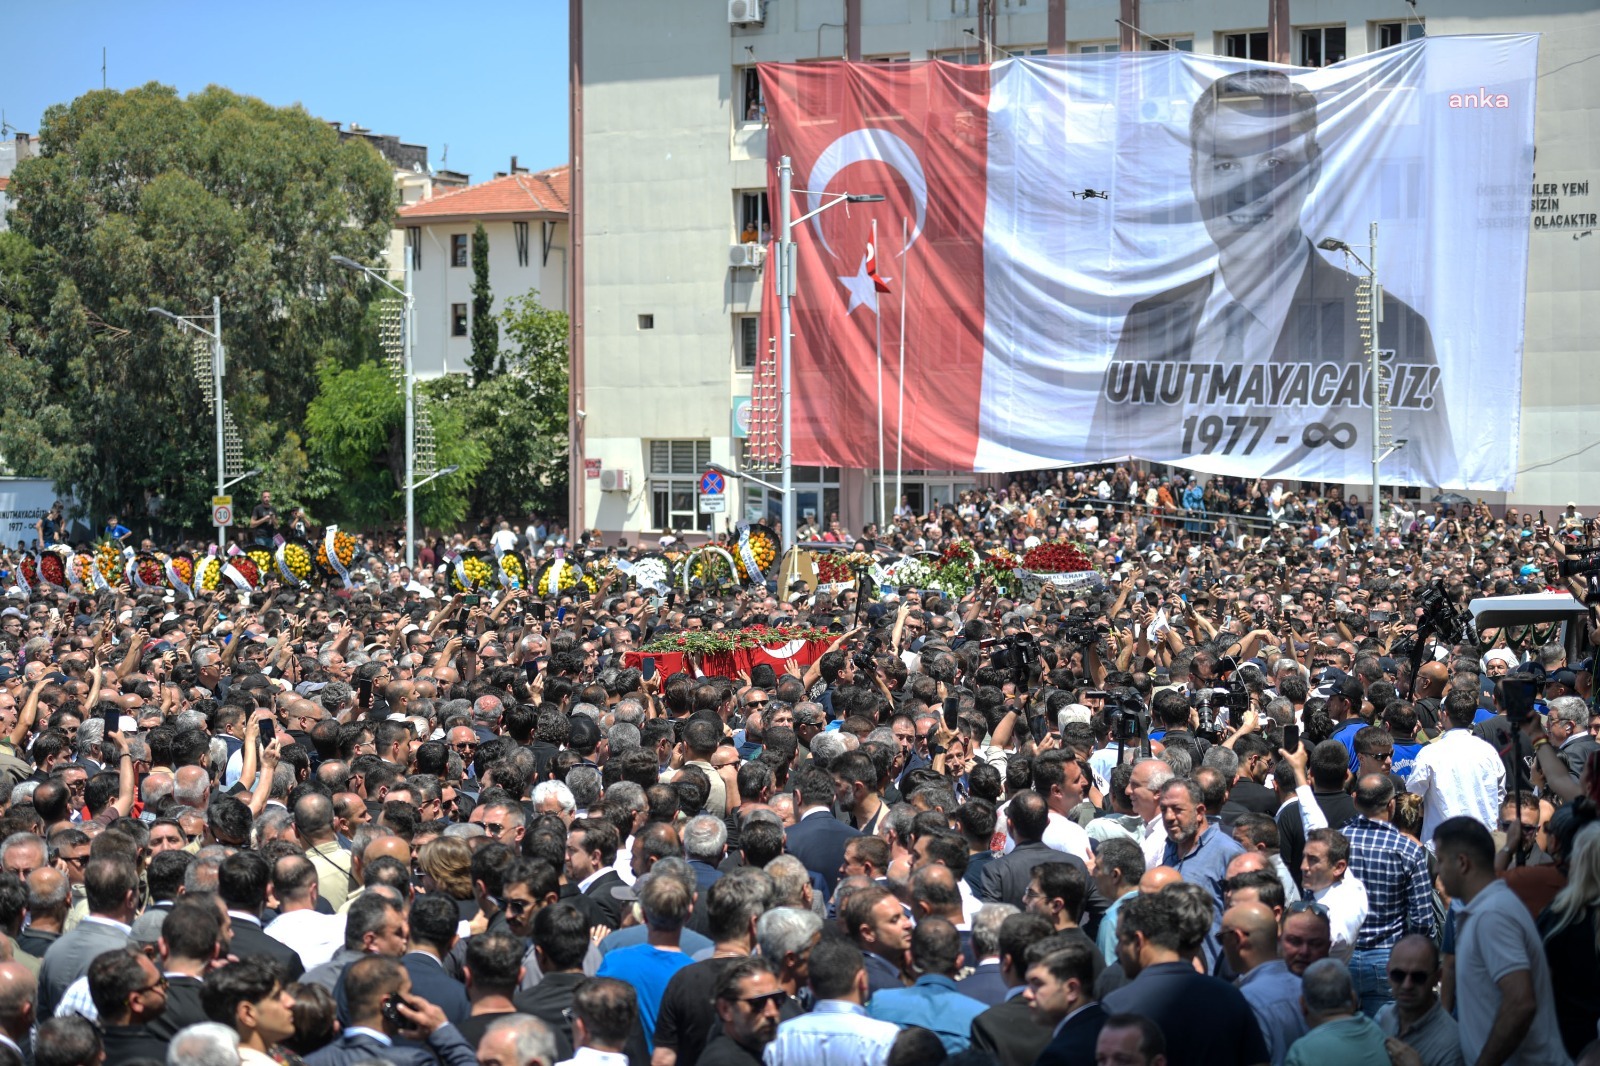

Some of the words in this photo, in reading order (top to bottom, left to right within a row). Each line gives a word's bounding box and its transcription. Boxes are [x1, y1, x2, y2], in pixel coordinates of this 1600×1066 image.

[1562, 179, 1589, 195] YENİ
[1534, 213, 1598, 227] OLACAKTIR
[1105, 350, 1440, 411] UNUTMAYACAĞIZ!
[1181, 415, 1273, 455] 1977
[218, 511, 228, 520] 30
[9, 523, 23, 531] 1977
